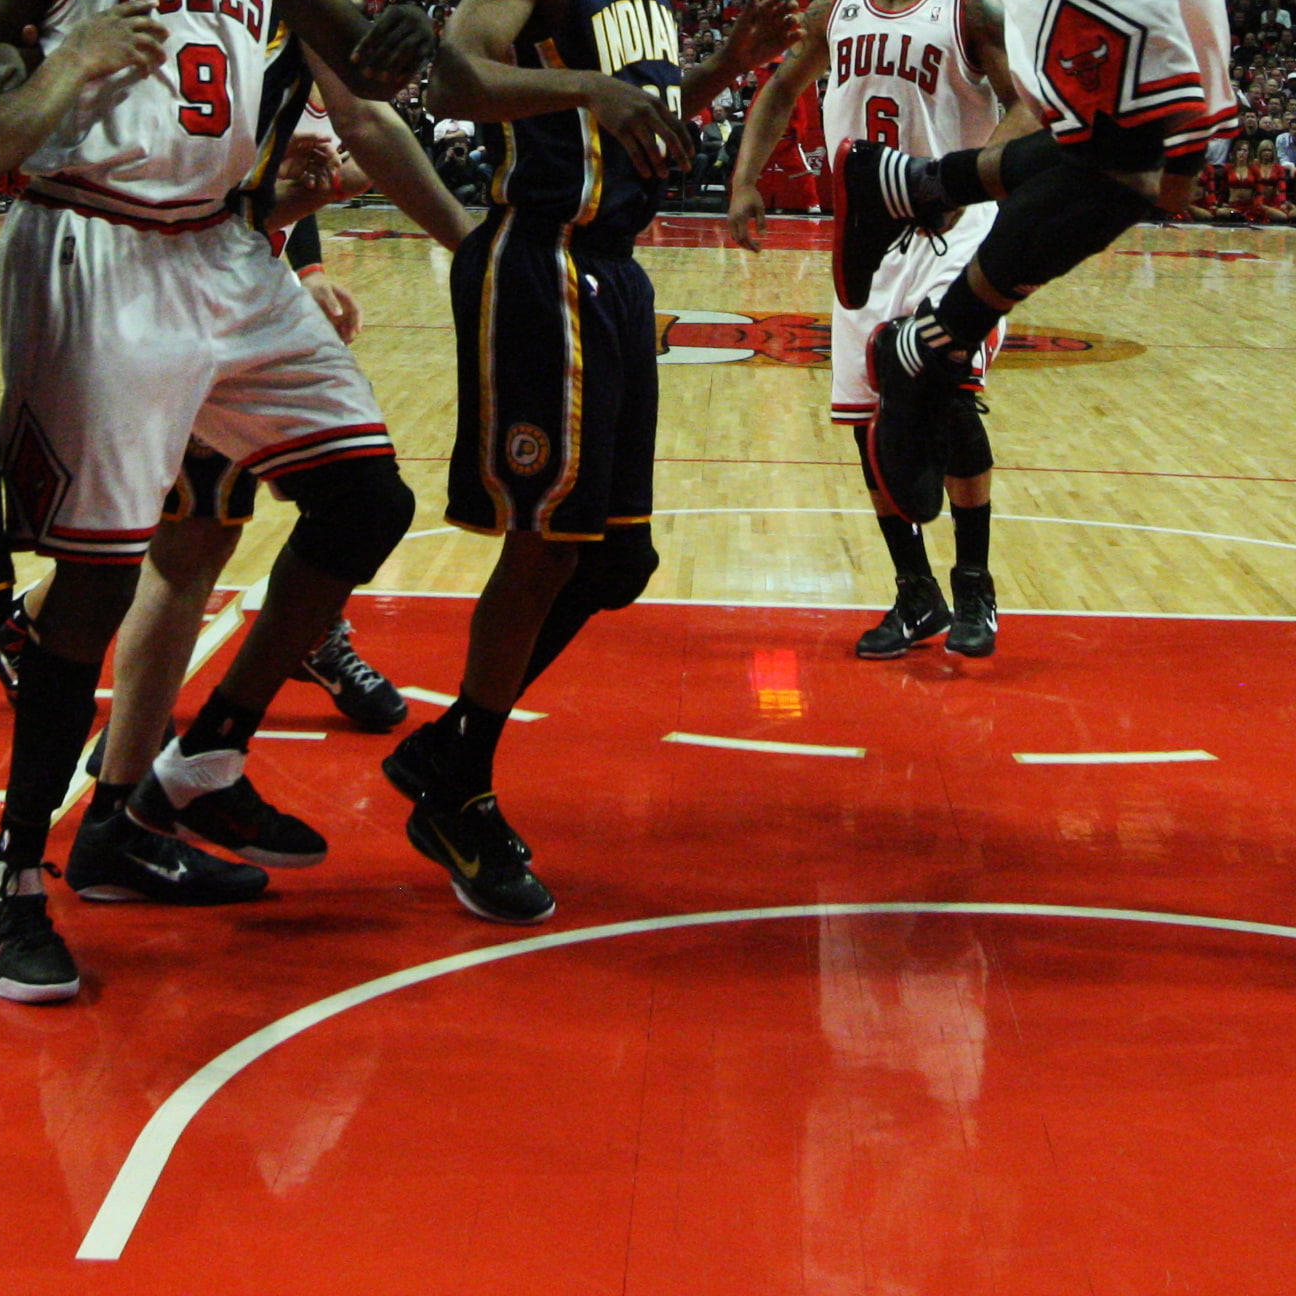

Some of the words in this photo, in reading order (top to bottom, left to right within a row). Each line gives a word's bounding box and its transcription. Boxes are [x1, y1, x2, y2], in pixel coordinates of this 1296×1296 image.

[176, 42, 232, 138] 9
[836, 33, 943, 95] BULLS
[864, 95, 901, 146] 6
